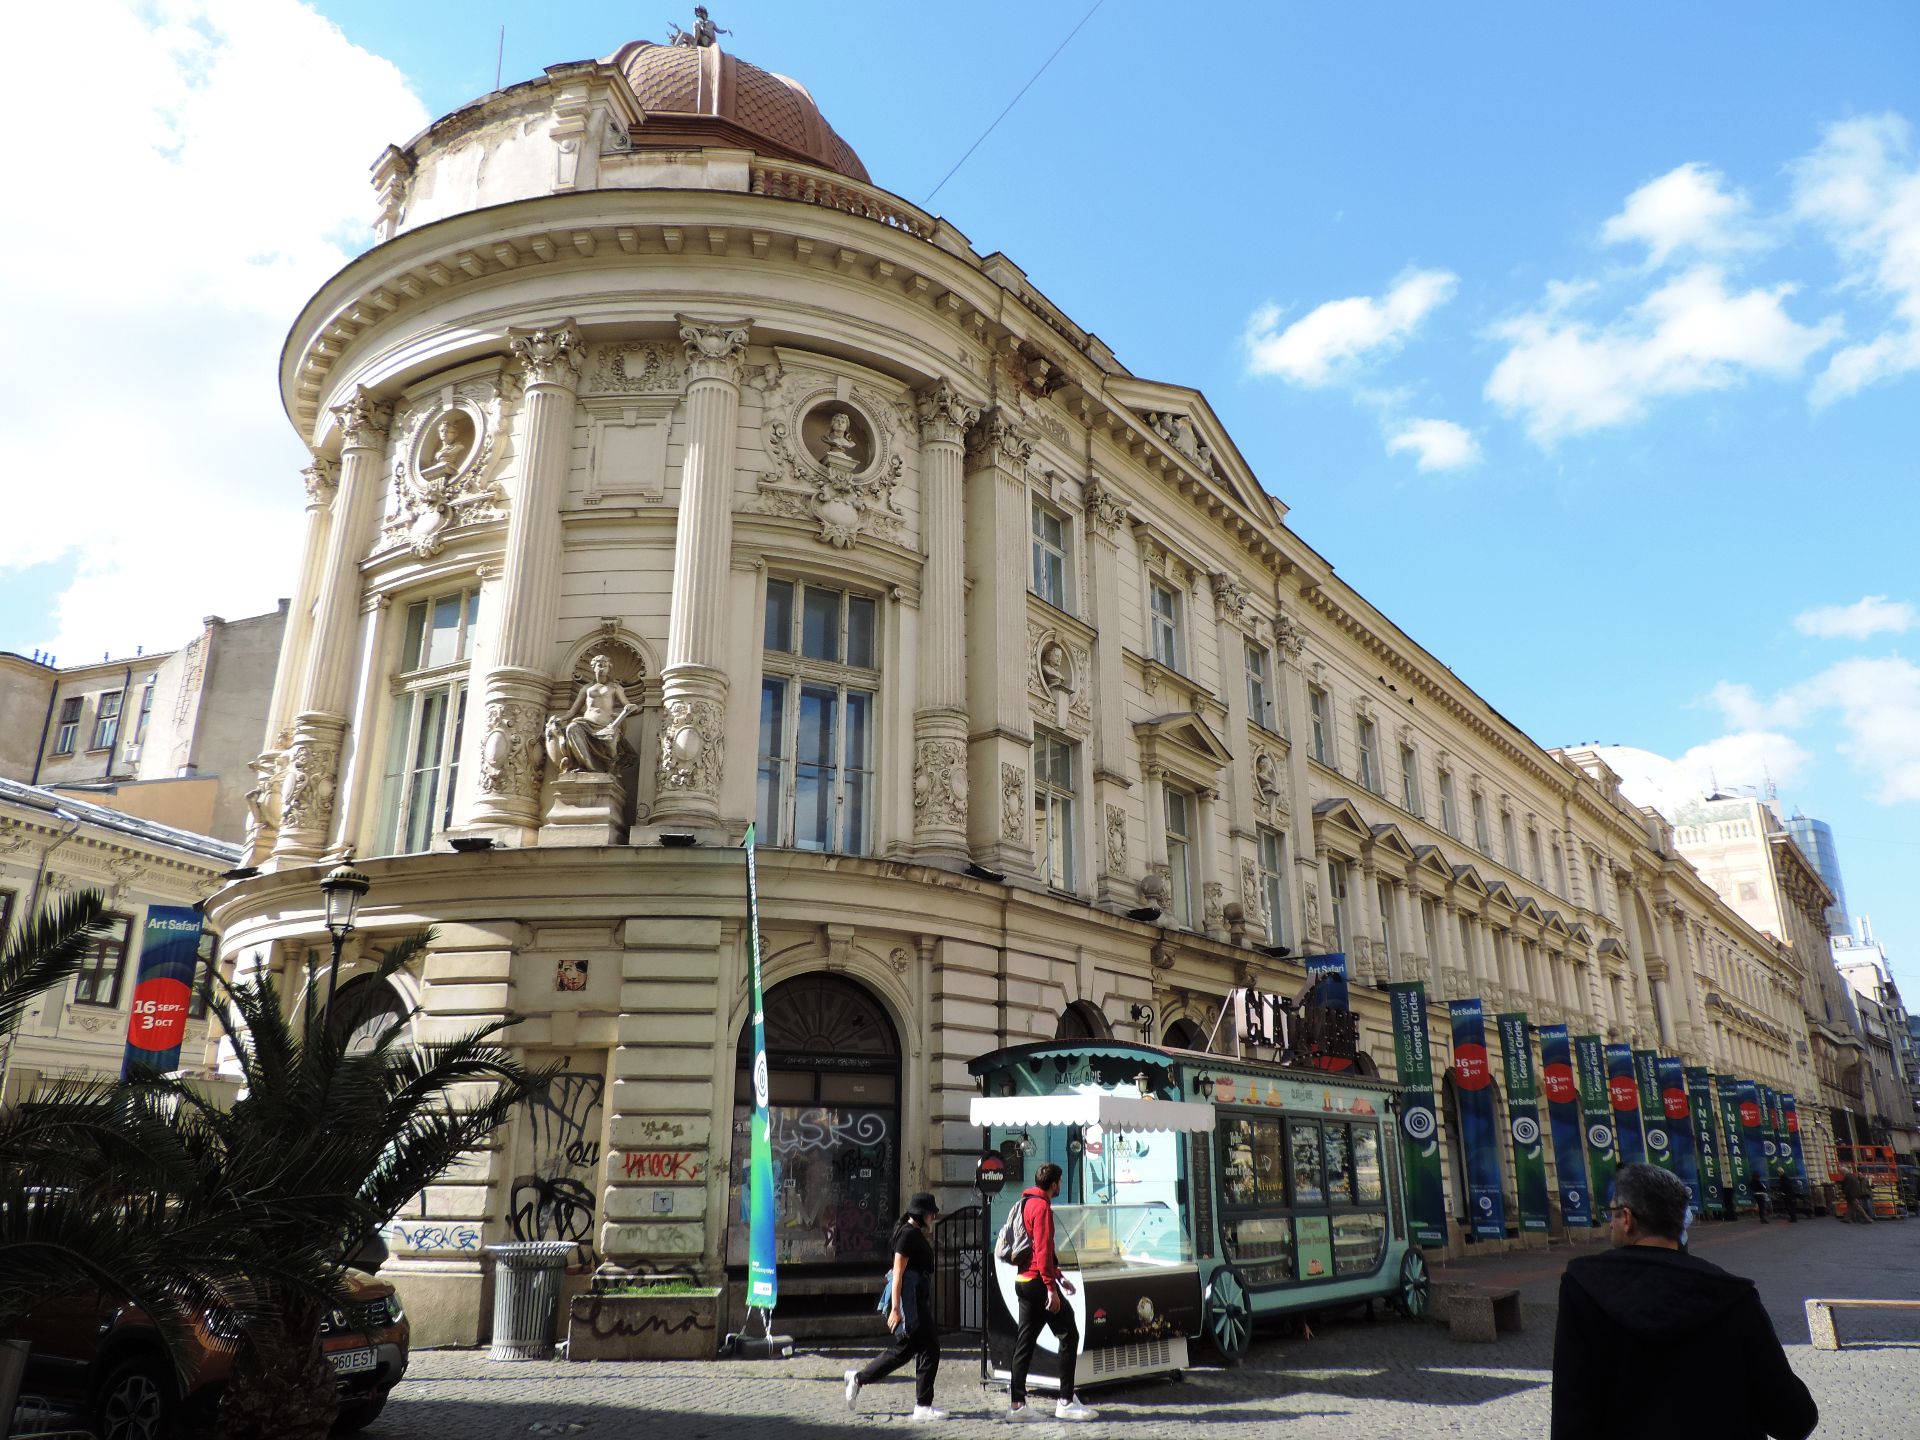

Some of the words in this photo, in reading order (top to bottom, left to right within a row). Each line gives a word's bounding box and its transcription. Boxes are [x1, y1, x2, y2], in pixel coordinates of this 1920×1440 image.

[148, 919, 167, 929] Art
[168, 920, 201, 931] Safari
[1308, 966, 1320, 974] Art
[1321, 964, 1345, 973] Safari
[134, 1000, 156, 1014] 16
[1398, 993, 1411, 1032] yourself
[1410, 991, 1420, 1023] Circles
[1462, 1008, 1481, 1016] Safari
[141, 1016, 154, 1029] 3
[1515, 1020, 1524, 1047] Circles
[1413, 1027, 1423, 1060] George
[1403, 1034, 1414, 1072] Express
[1416, 1063, 1424, 1071] in
[1456, 1059, 1469, 1067] 16
[1518, 1049, 1528, 1079] George
[1462, 1068, 1470, 1077] 3
[1509, 1056, 1519, 1088] Express
[1546, 1076, 1557, 1084] 16
[1412, 1084, 1433, 1092] Safari
[1552, 1085, 1559, 1093] 3
[1697, 1096, 1715, 1177] INTRARE
[1727, 1102, 1744, 1176] INTRARE
